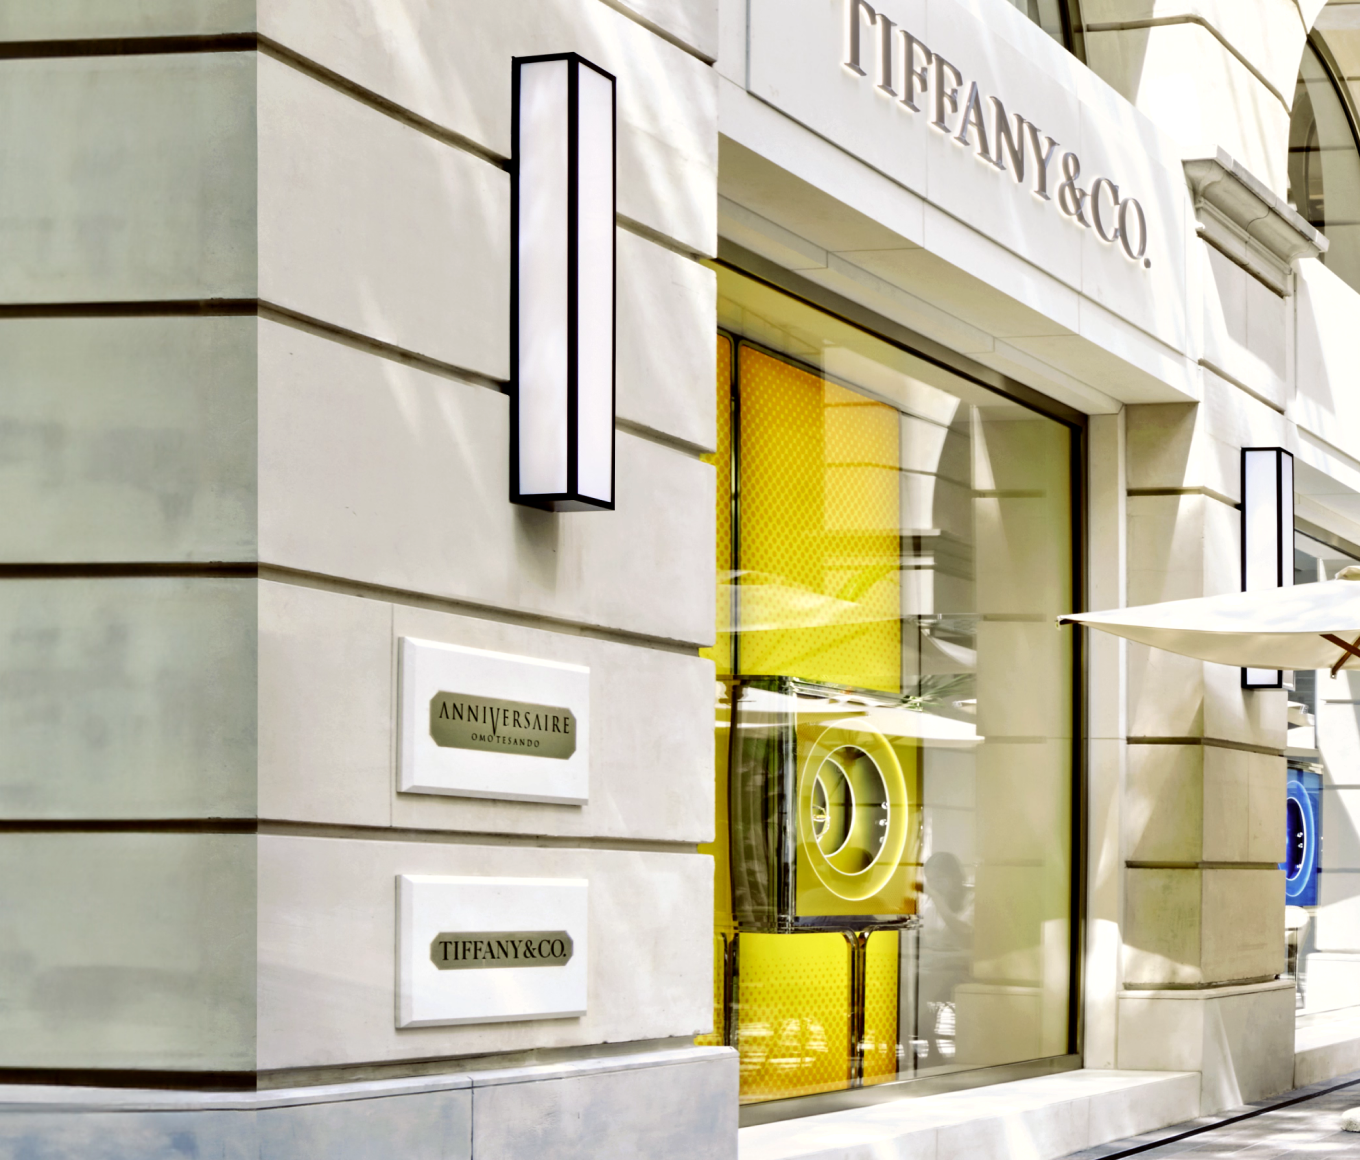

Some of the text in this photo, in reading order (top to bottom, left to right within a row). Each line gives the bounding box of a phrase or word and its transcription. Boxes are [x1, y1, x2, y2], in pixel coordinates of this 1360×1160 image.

[843, 0, 1151, 268] TIFFANY&CO.
[439, 701, 570, 736] ANNIVERSAIRE
[471, 732, 540, 748] OMOTESANDO
[439, 939, 567, 961] TIFFANY&CO.
